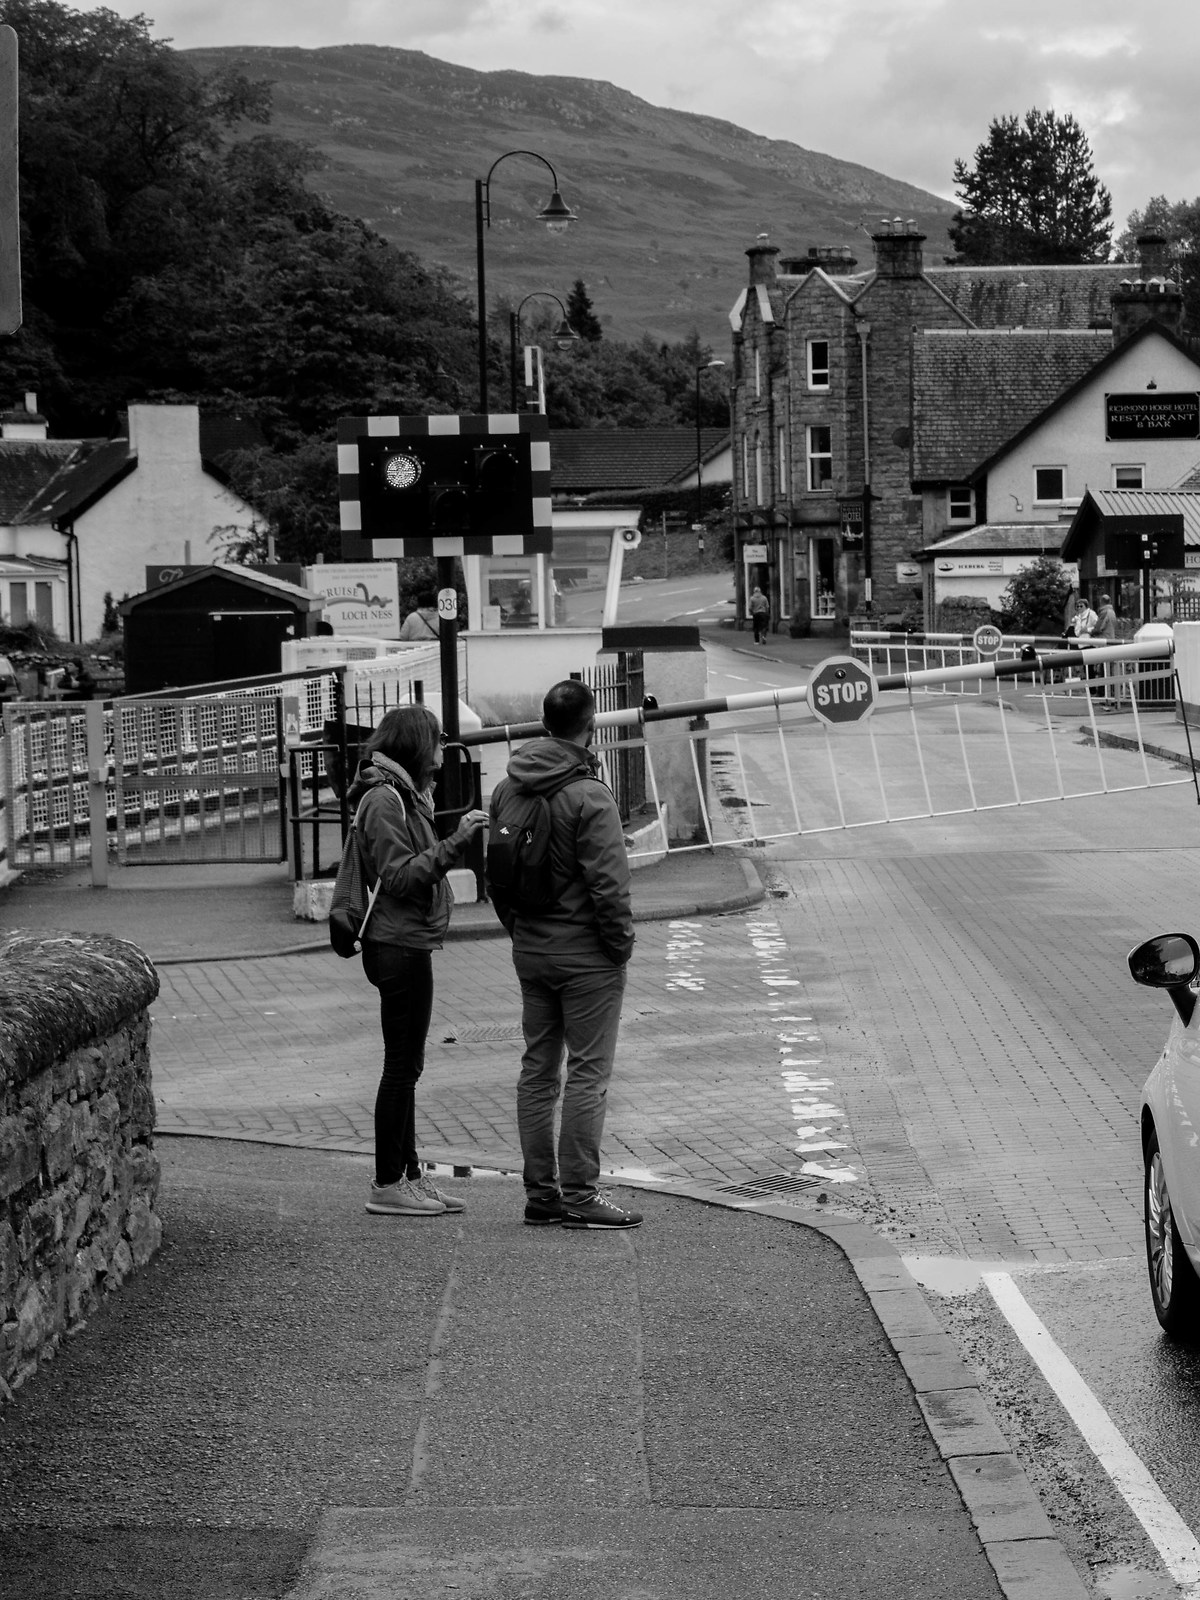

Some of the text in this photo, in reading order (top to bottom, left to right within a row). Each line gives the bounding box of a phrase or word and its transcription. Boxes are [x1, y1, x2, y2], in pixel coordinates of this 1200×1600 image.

[1174, 403, 1198, 411] HOTEL
[1111, 413, 1195, 422] RESTAURANT
[342, 610, 393, 620] LOCH NESS
[977, 635, 999, 645] STOP
[816, 680, 868, 706] STOP
